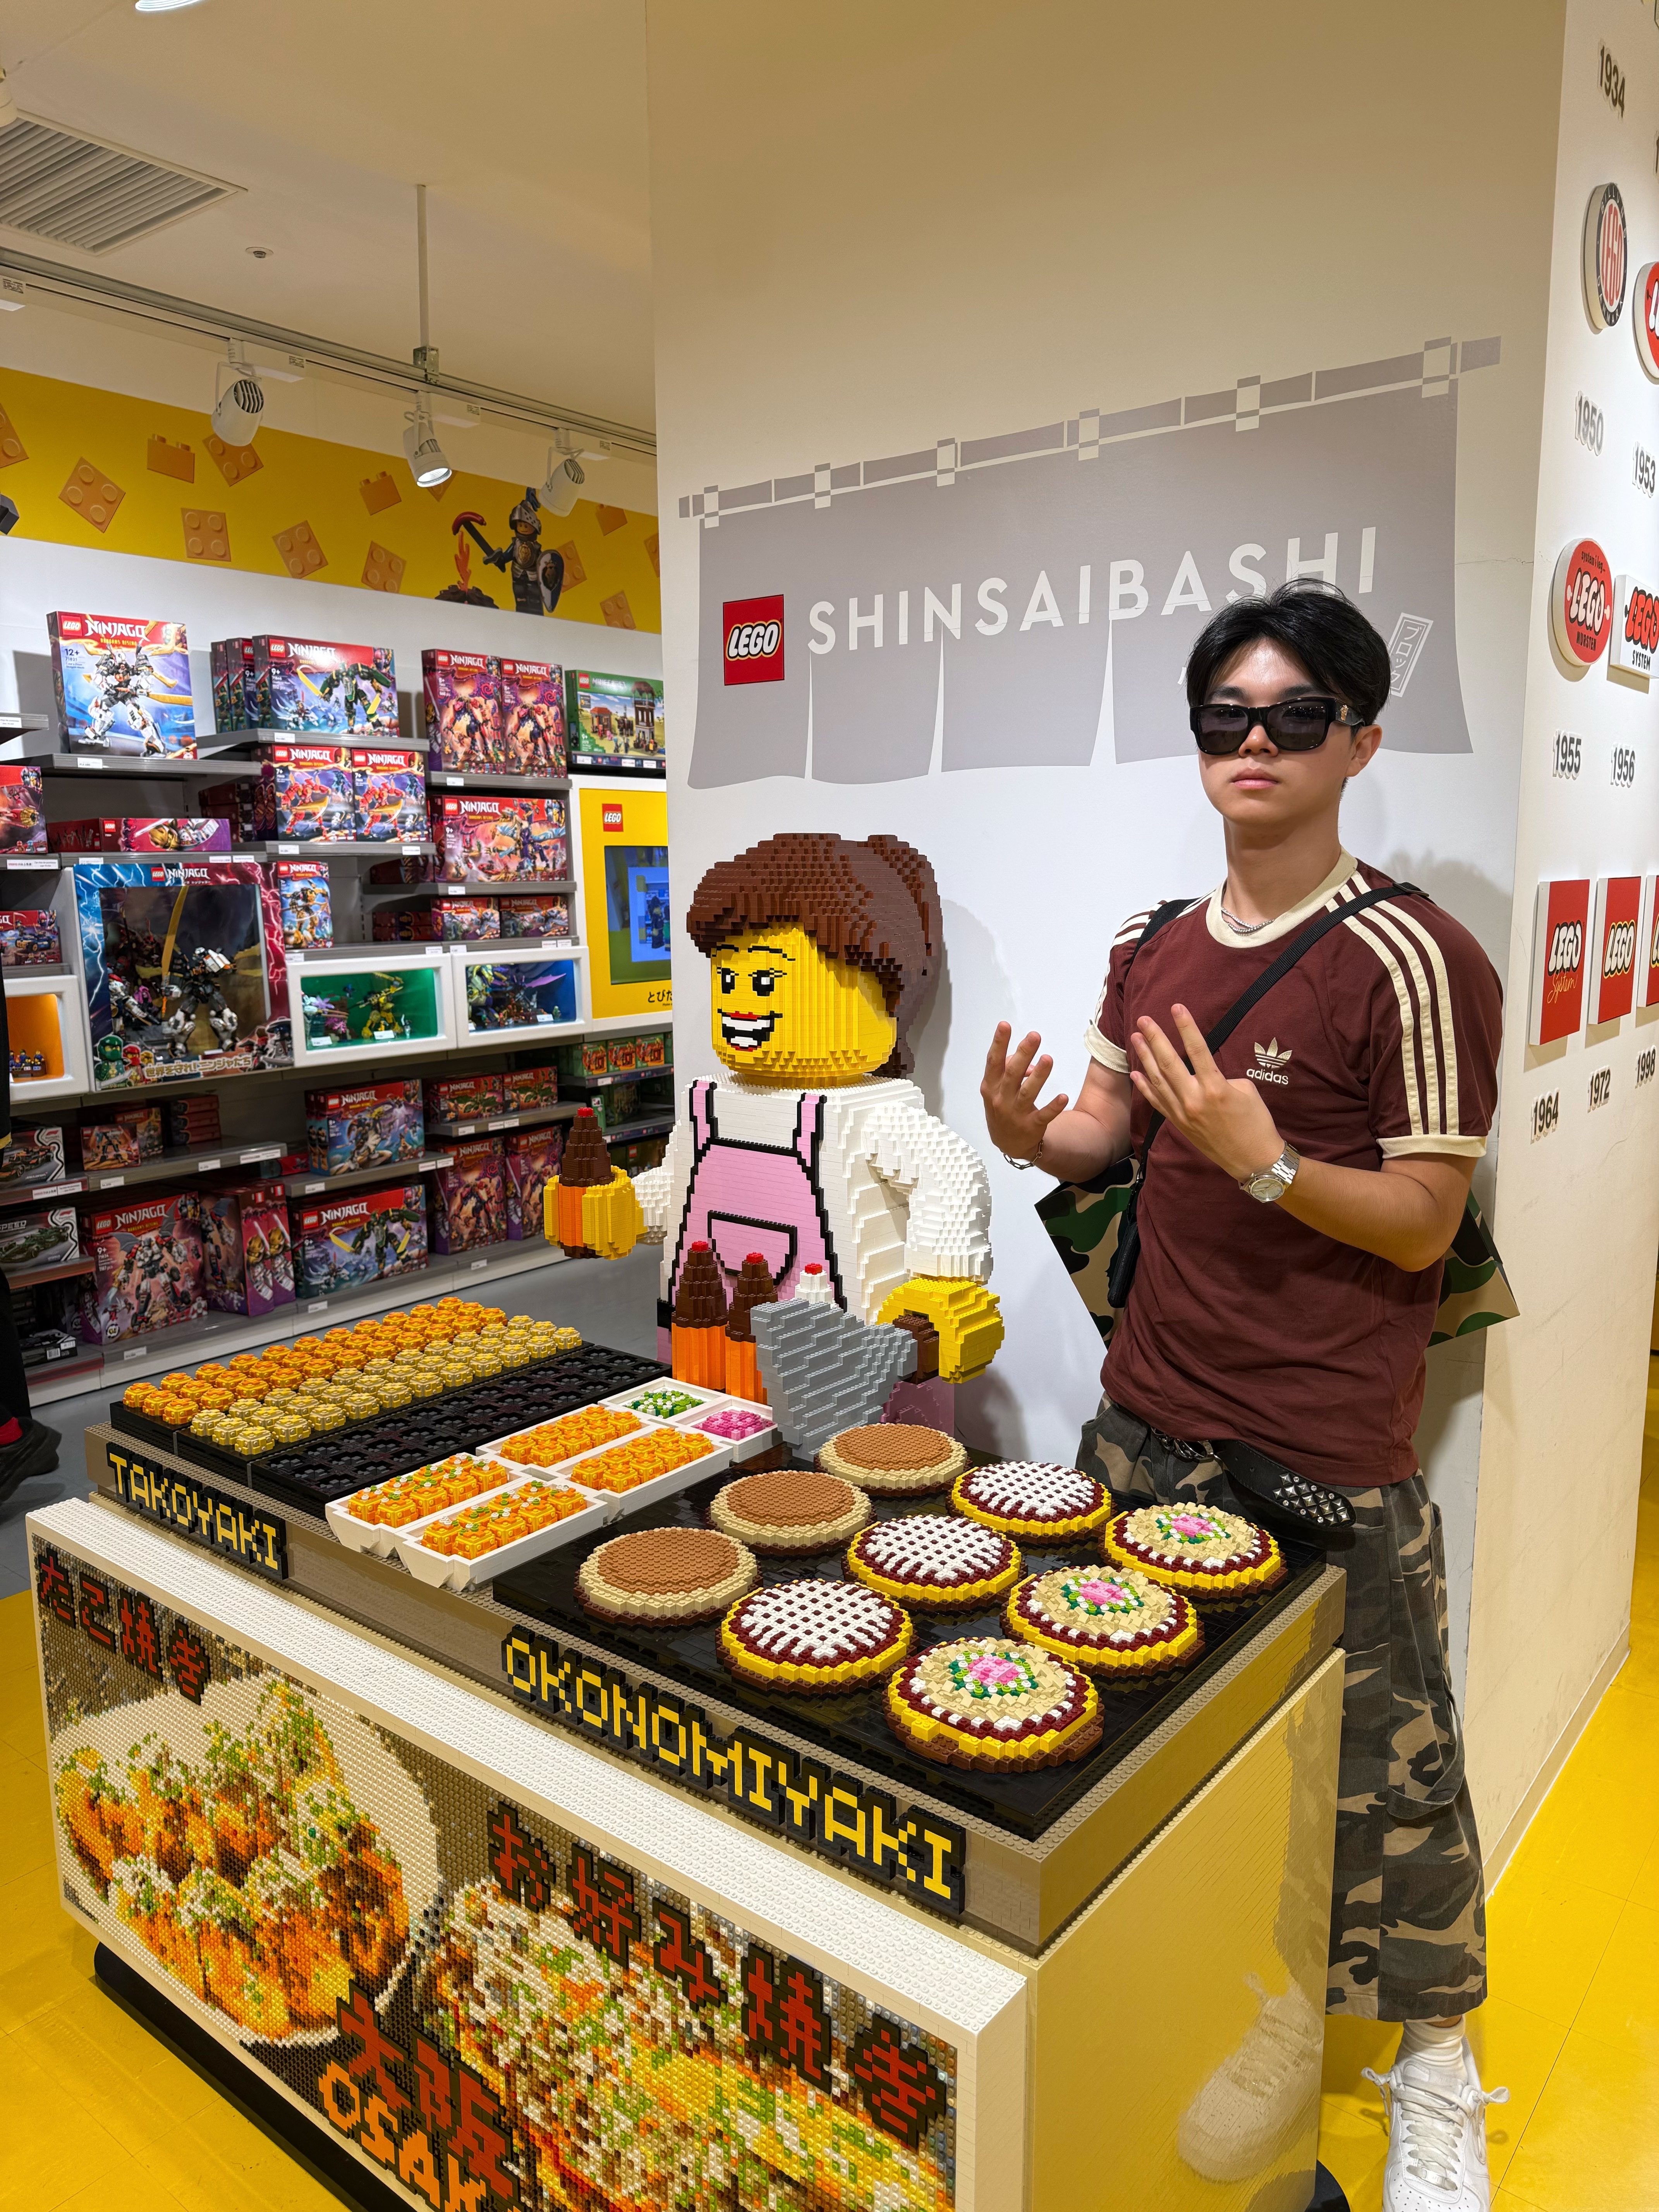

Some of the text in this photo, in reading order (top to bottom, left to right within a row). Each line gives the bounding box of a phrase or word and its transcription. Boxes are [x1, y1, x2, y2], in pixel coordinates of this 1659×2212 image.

[1600, 45, 1625, 118] 1934
[1578, 395, 1603, 451] 1950
[1635, 447, 1656, 494] 1953
[726, 527, 1376, 661] LEGO SHINSAIBASHI
[1570, 567, 1605, 635] LEGO
[63, 620, 150, 641] LEGO NINJAGO
[1625, 586, 1659, 654] LEGO
[1390, 626, 1422, 683] ブロック
[1577, 632, 1596, 651] MURSTEN
[450, 654, 486, 670] NINJAGO
[515, 663, 548, 678] NINJAGO
[1632, 650, 1650, 671] SYSTEM
[289, 748, 333, 763] NINJAGO
[367, 752, 407, 767] NINJAGO
[1556, 734, 1581, 773] 1955
[1613, 747, 1635, 782] 1956
[459, 800, 502, 816] NINJAGO
[604, 812, 622, 824] LEGO
[167, 868, 211, 881] NINJAGO
[1548, 920, 1582, 976] LEGO
[1603, 919, 1636, 979] LEGO
[1547, 968, 1578, 1004] System
[146, 1057, 251, 1076] 世界を守れ! ニンジャたち
[1246, 1068, 1289, 1085] adidas
[1637, 1049, 1656, 1083] 1998
[341, 1091, 378, 1107] NINJAGO
[1590, 1069, 1611, 1106] 1972
[1534, 1092, 1559, 1135] 1964
[97, 1204, 169, 1231] LEGO NINJAGO
[320, 1202, 371, 1226] NINJAGO
[110, 1453, 278, 1570] TAKOYAKI
[41, 1556, 204, 1697] たこ焼き
[506, 1637, 953, 1900] OKONOMIYAKI
[492, 1814, 937, 2139] お好み焼き
[341, 1991, 513, 2200] 大阪
[318, 2060, 521, 2212] OSAK
